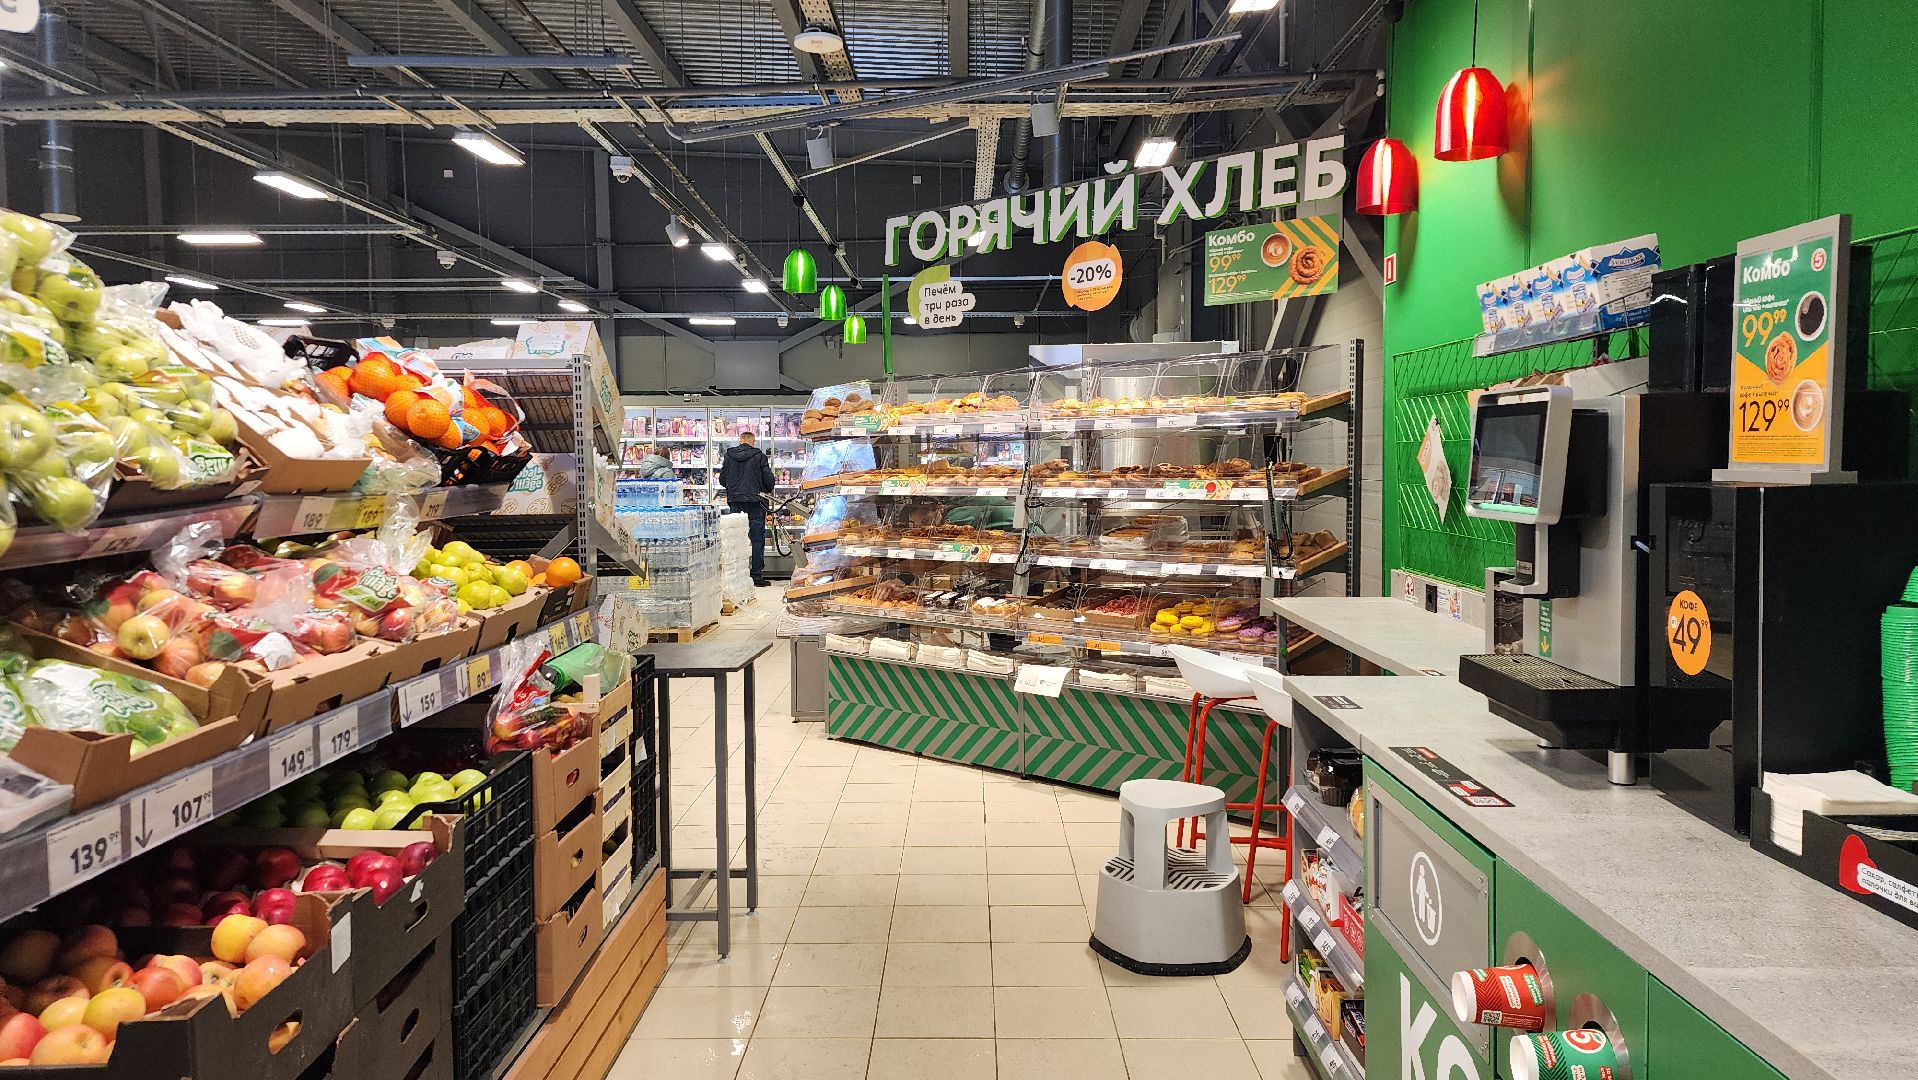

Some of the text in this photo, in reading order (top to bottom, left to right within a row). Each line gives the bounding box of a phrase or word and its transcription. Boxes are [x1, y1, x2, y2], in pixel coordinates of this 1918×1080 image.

[884, 135, 1350, 267] ГОРЯЧИЙ ХЛЕБ
[1208, 230, 1256, 247] Комбо
[1070, 263, 1112, 284] -20%
[1208, 254, 1232, 272] 99
[1743, 257, 1791, 284] Комбо
[924, 283, 957, 297] Печём
[1208, 275, 1238, 295] 129
[924, 298, 969, 313] три раза
[924, 313, 957, 325] в день
[1742, 308, 1788, 347] 99 99
[1739, 399, 1790, 432] 129 99
[304, 512, 323, 528] 189
[1680, 599, 1698, 612] КОФЕ
[1672, 613, 1702, 656] 49
[420, 692, 435, 713] 159
[331, 729, 351, 754] 179
[281, 749, 305, 778] 149
[172, 795, 203, 828] 107
[70, 837, 108, 875] 139
[1888, 880, 1918, 898] салфет
